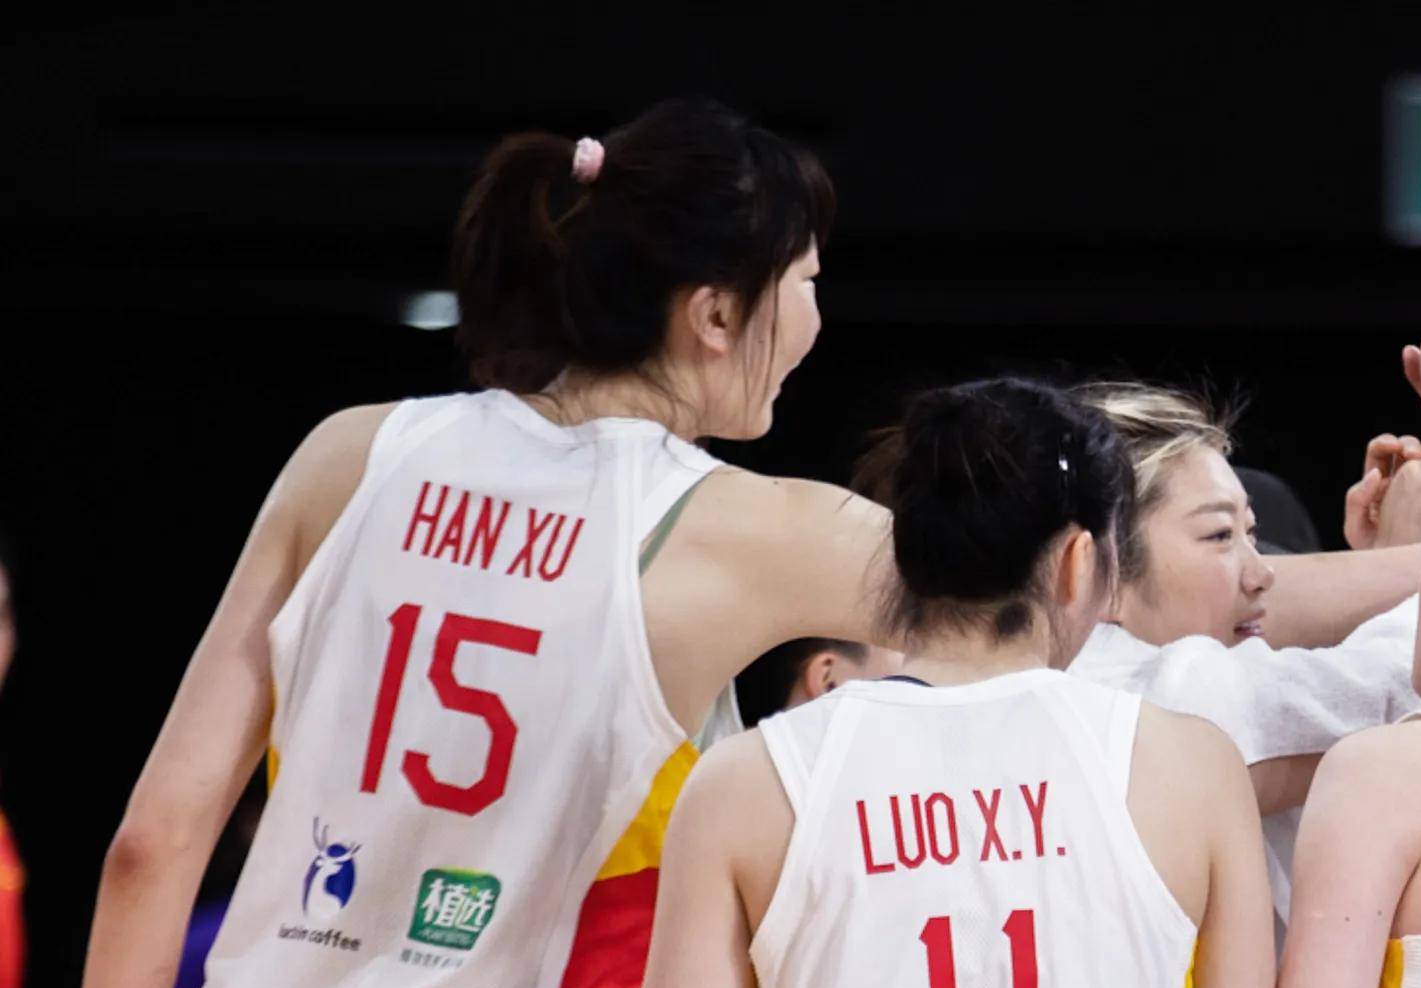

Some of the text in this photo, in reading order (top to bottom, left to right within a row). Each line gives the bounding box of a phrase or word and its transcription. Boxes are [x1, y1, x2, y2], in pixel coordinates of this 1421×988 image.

[402, 480, 586, 582] HAN XU
[359, 602, 544, 817] 15
[855, 780, 1067, 875] LUO X.Y.
[421, 878, 494, 932] 植选
